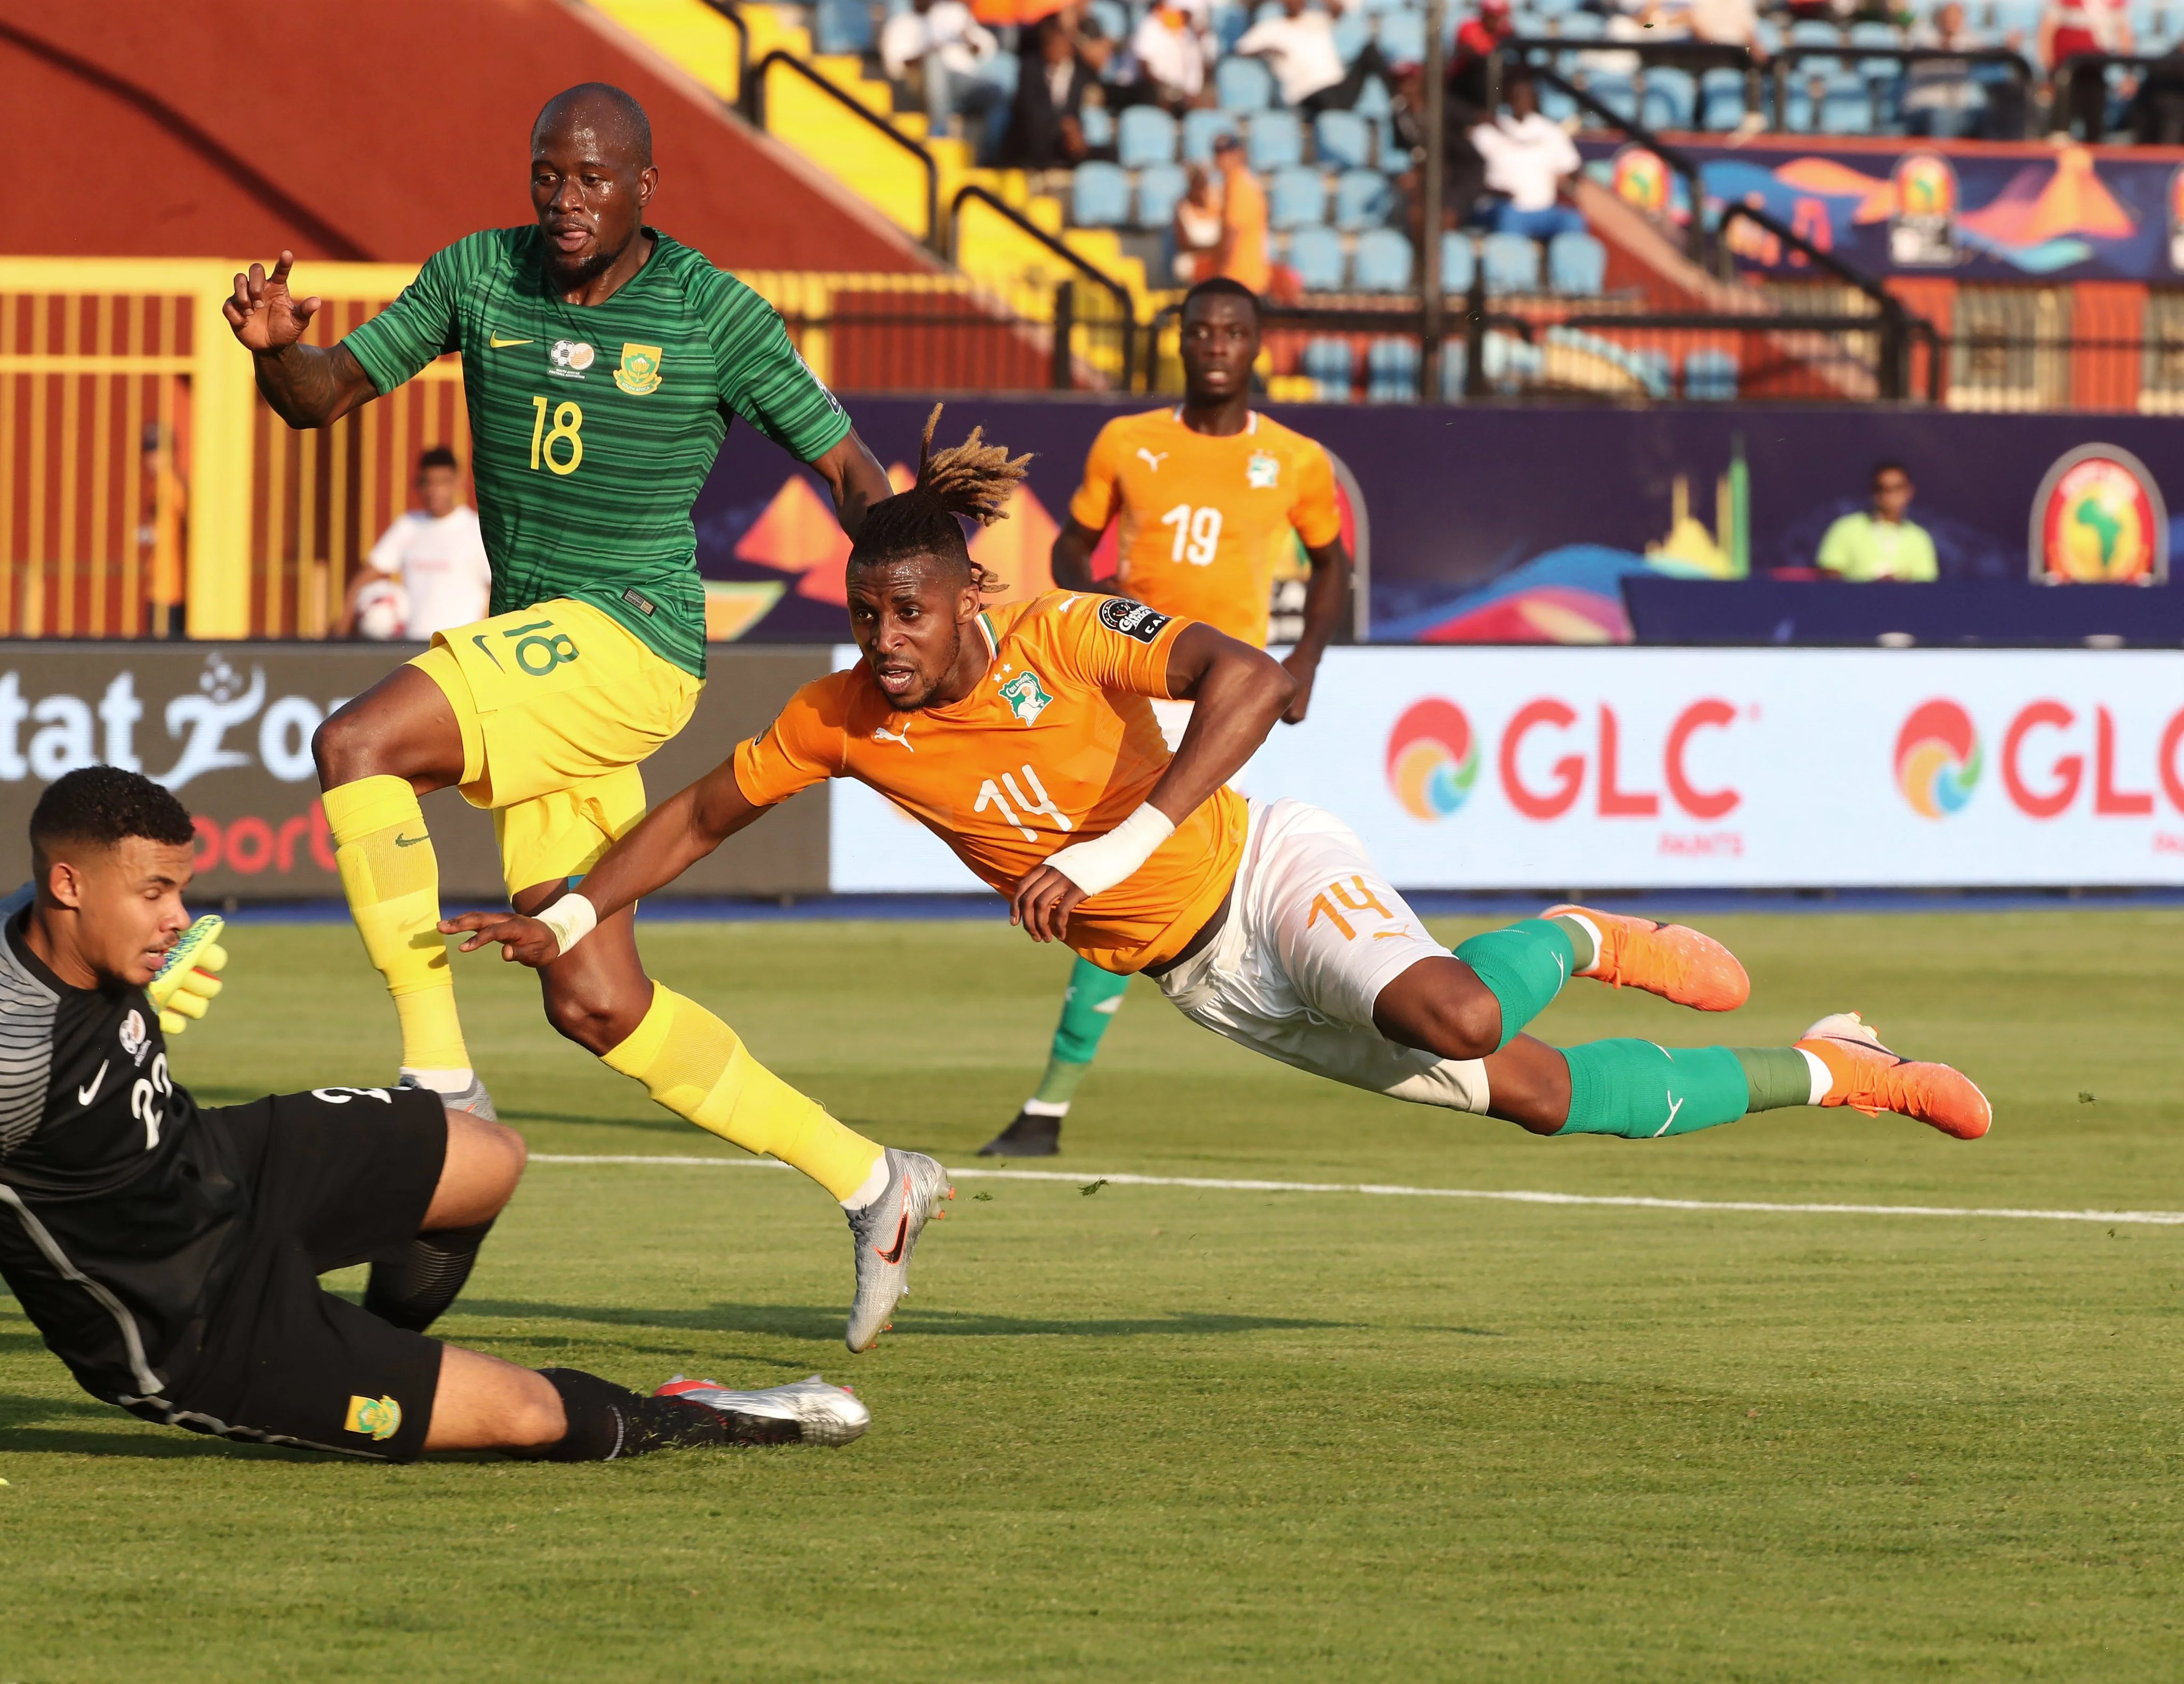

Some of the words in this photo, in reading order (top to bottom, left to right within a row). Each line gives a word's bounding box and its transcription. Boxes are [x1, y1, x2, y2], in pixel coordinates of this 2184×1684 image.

[530, 396, 583, 475] 18
[1161, 504, 1223, 566] 19
[502, 620, 580, 676] 18
[1499, 695, 1741, 821] GLC
[973, 764, 1073, 843] 14
[1307, 875, 1394, 941] 14
